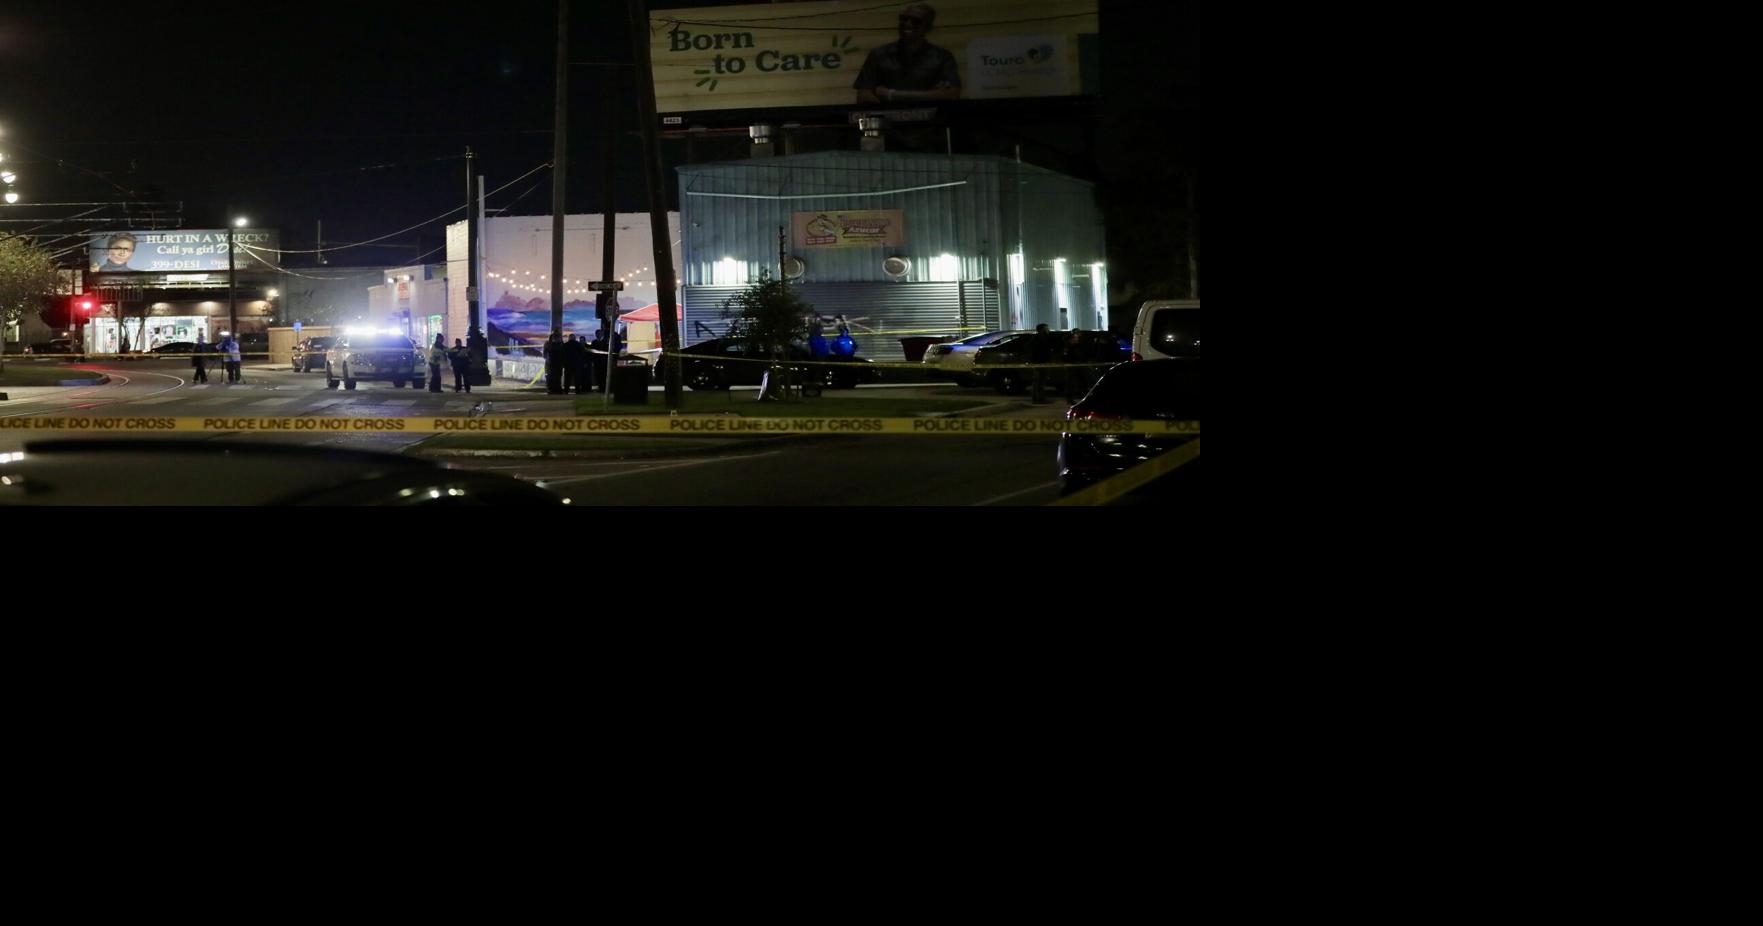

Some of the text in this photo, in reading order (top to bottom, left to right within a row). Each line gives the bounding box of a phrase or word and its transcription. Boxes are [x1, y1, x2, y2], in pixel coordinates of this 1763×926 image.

[669, 30, 754, 52] Born
[714, 50, 841, 74] to Care
[980, 55, 1025, 66] Touro
[146, 234, 183, 244] HURT
[185, 234, 201, 243] IN
[202, 234, 212, 243] A
[157, 245, 180, 255] Call
[182, 246, 194, 255] ya
[195, 245, 214, 256] girl
[0, 418, 177, 429] LICE LINE DO NOT CROSS
[204, 418, 405, 430] POLICE LINE DO NOT CROSS
[433, 419, 641, 430] POLICE LINE DO NOT CROSS
[670, 419, 882, 431] POLICE LINE DO NOT CROSS
[913, 420, 1134, 431] POLICE LINE DO NOT CROSS
